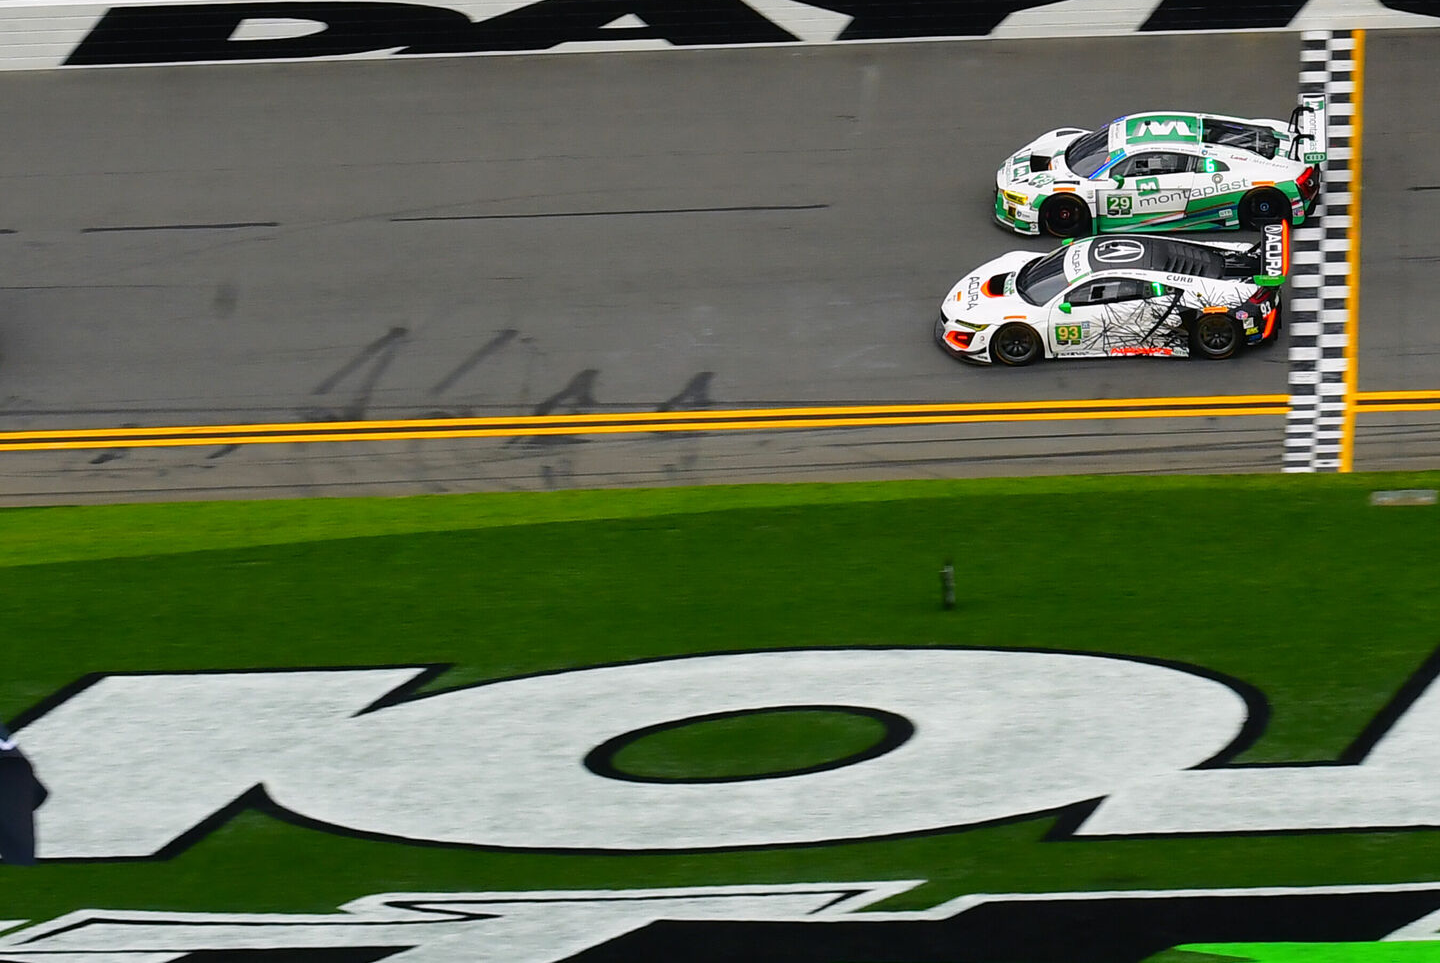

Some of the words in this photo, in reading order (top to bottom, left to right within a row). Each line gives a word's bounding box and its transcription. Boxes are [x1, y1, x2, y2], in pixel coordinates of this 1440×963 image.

[1204, 157, 1215, 173] 6
[1138, 176, 1249, 207] montaplast
[1109, 196, 1131, 210] 29
[1265, 233, 1282, 277] ACURA
[1166, 275, 1194, 283] CURB
[966, 276, 981, 311] ACURA
[1057, 326, 1079, 340] 93
